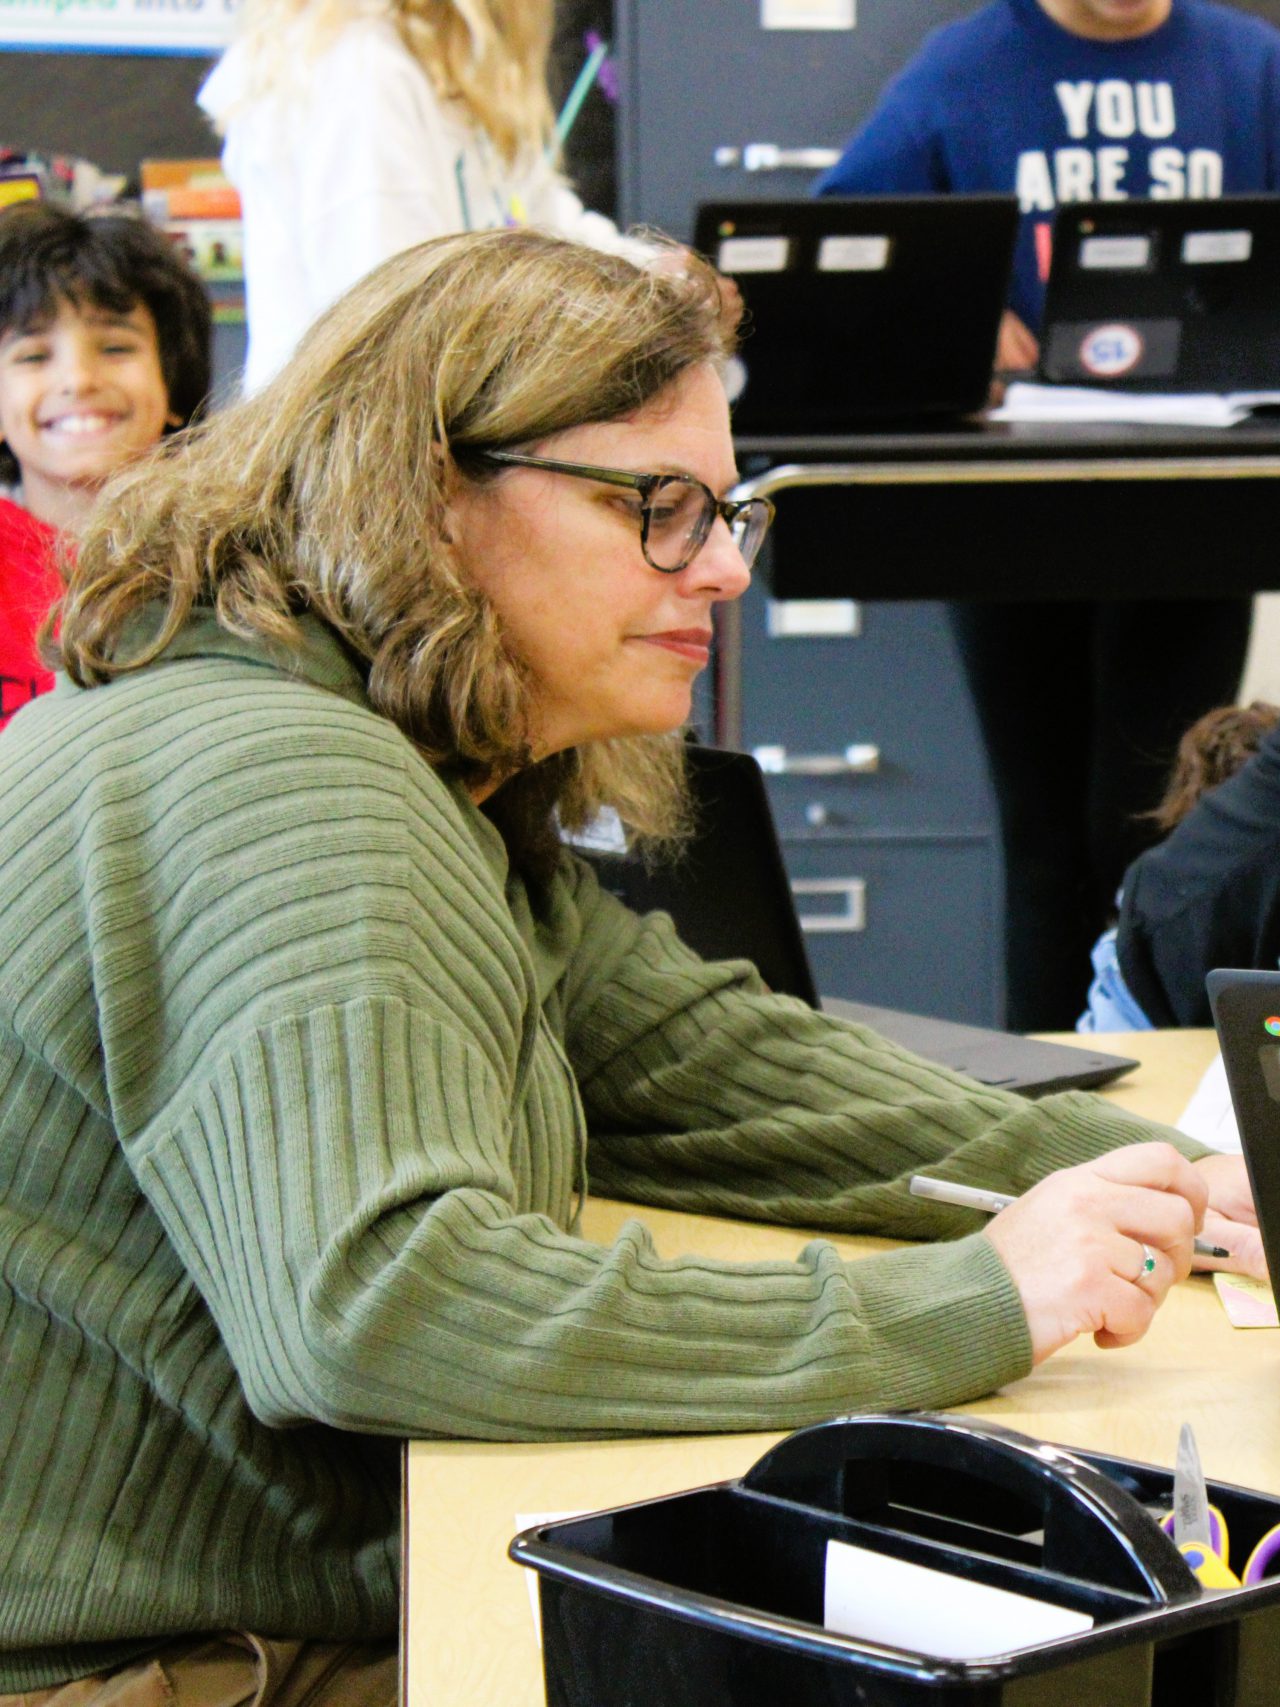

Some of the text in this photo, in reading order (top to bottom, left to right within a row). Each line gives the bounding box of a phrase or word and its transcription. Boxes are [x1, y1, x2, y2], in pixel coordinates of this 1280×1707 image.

[1054, 80, 1176, 138] YOU
[1016, 146, 1223, 214] ARE SO
